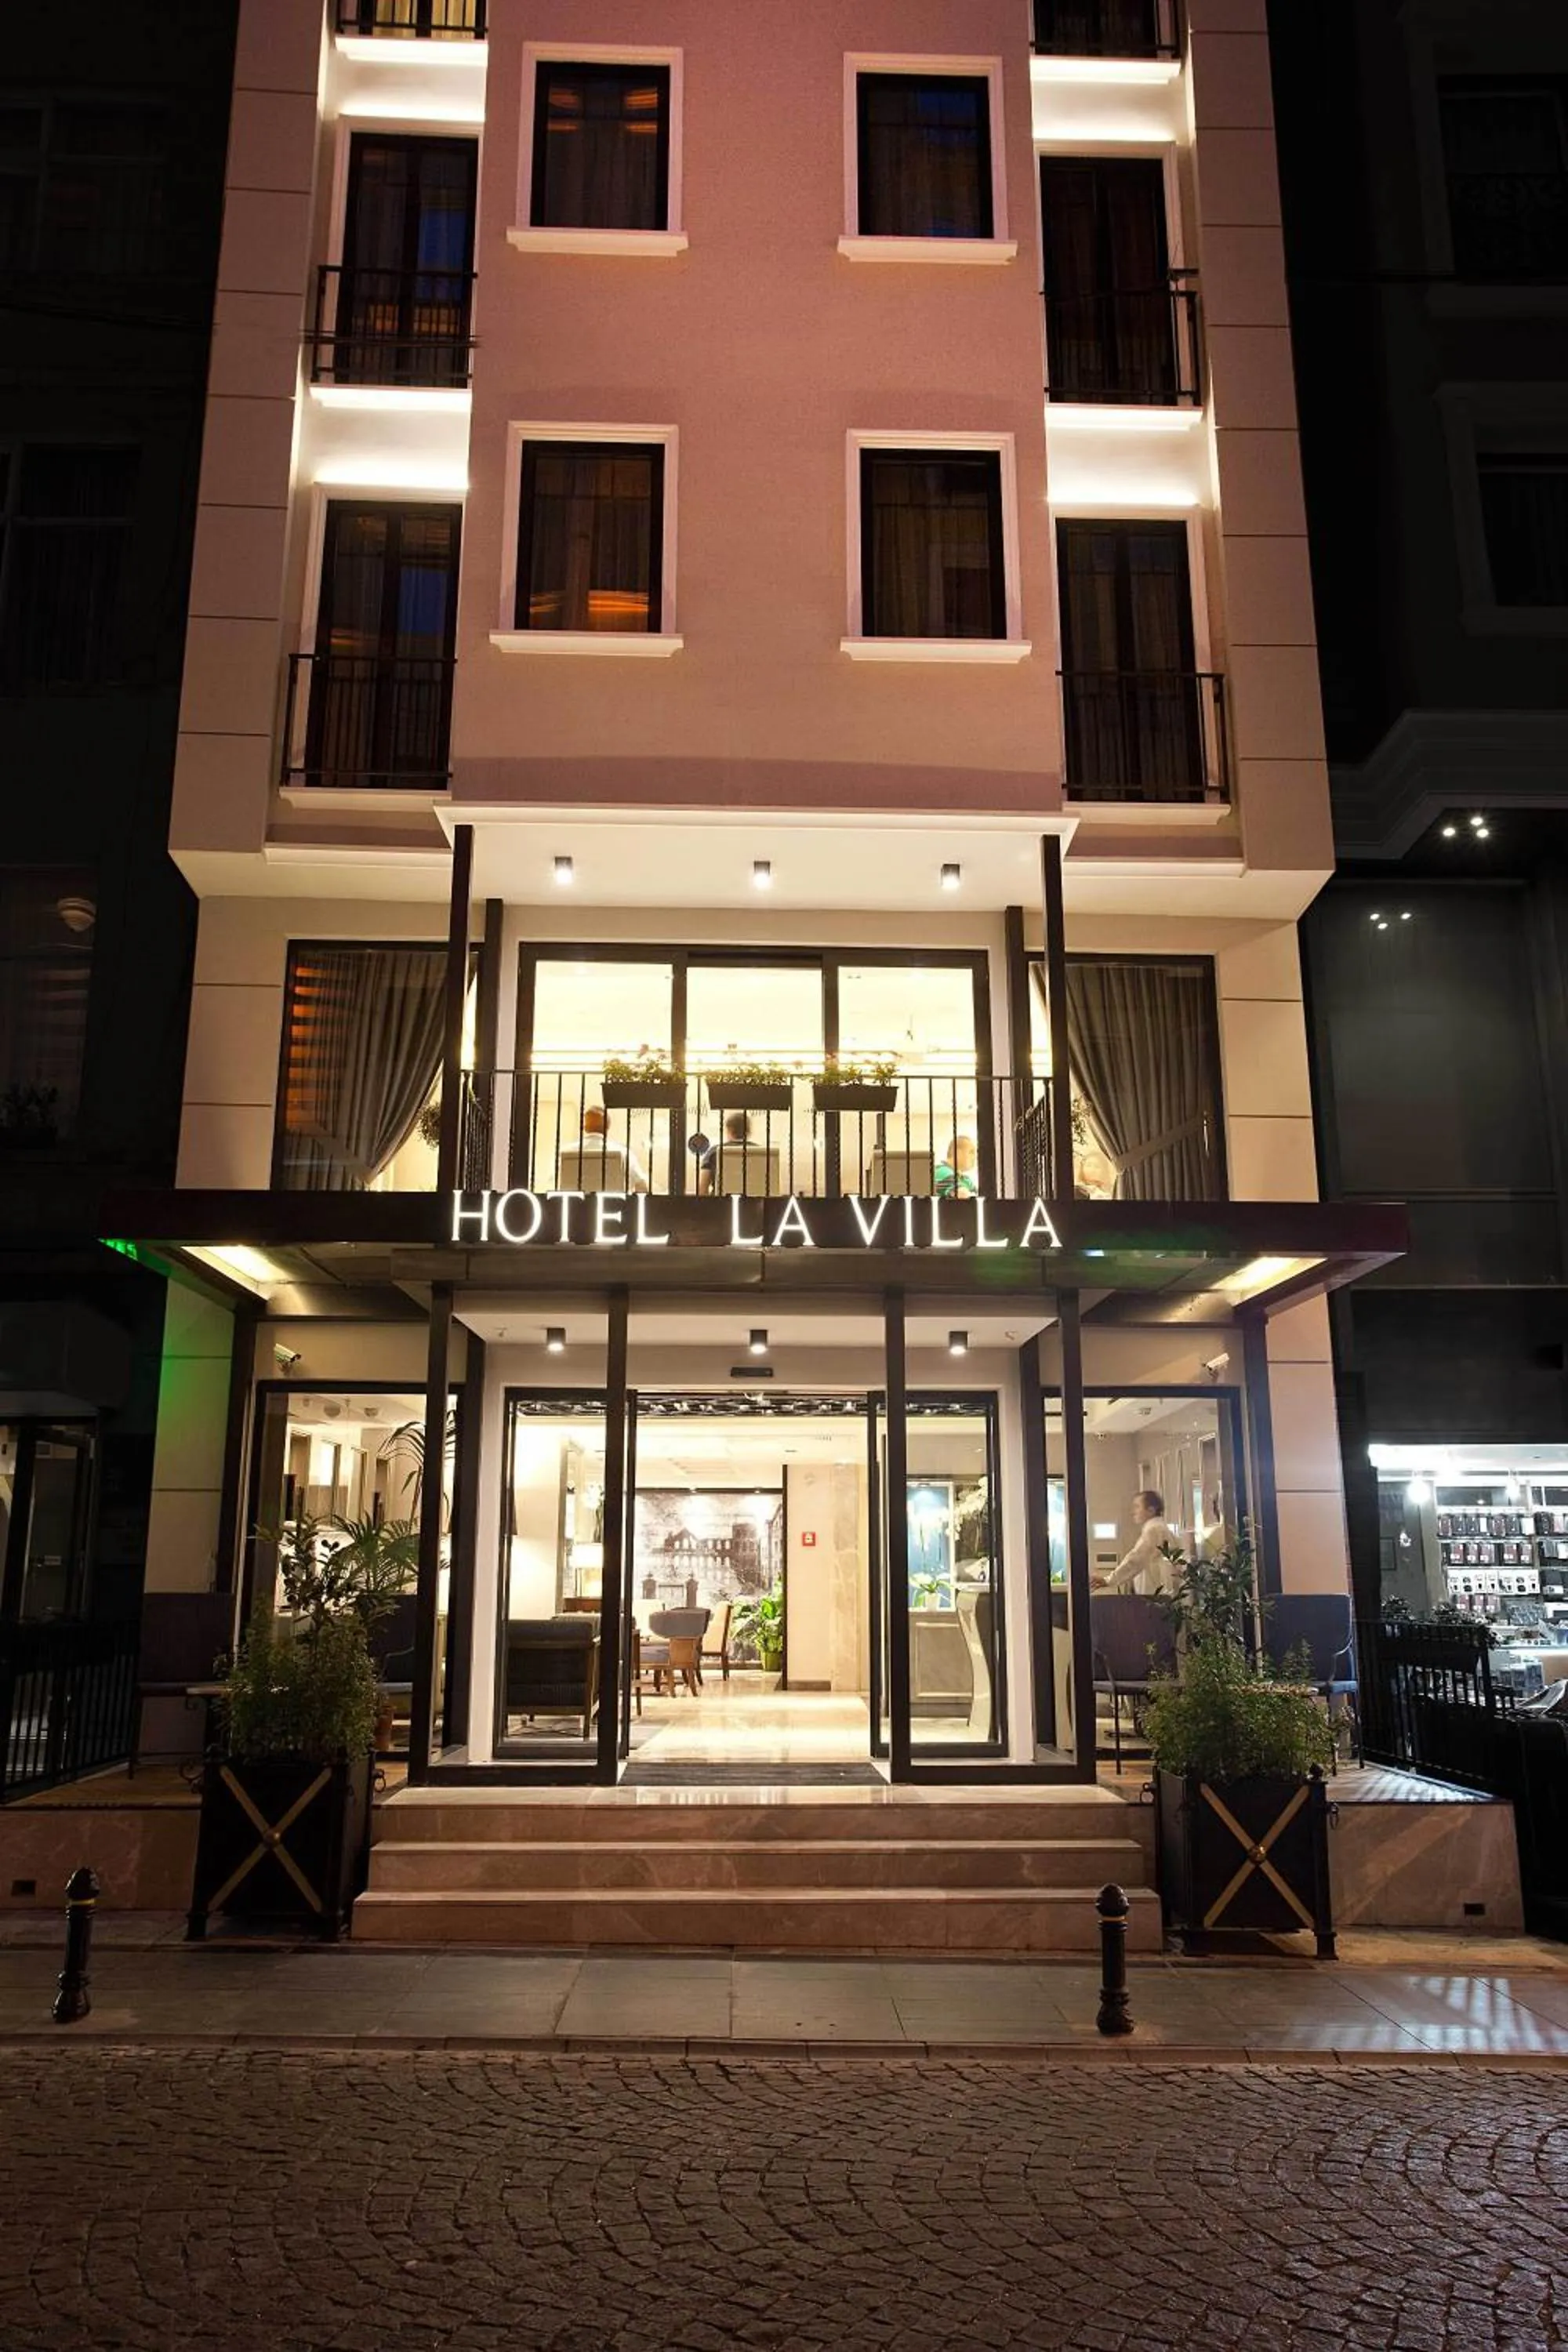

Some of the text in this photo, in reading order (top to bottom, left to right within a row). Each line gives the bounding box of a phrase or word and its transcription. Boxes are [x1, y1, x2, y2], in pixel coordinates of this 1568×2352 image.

[451, 1189, 1063, 1247] HOTEL LA VILLA
